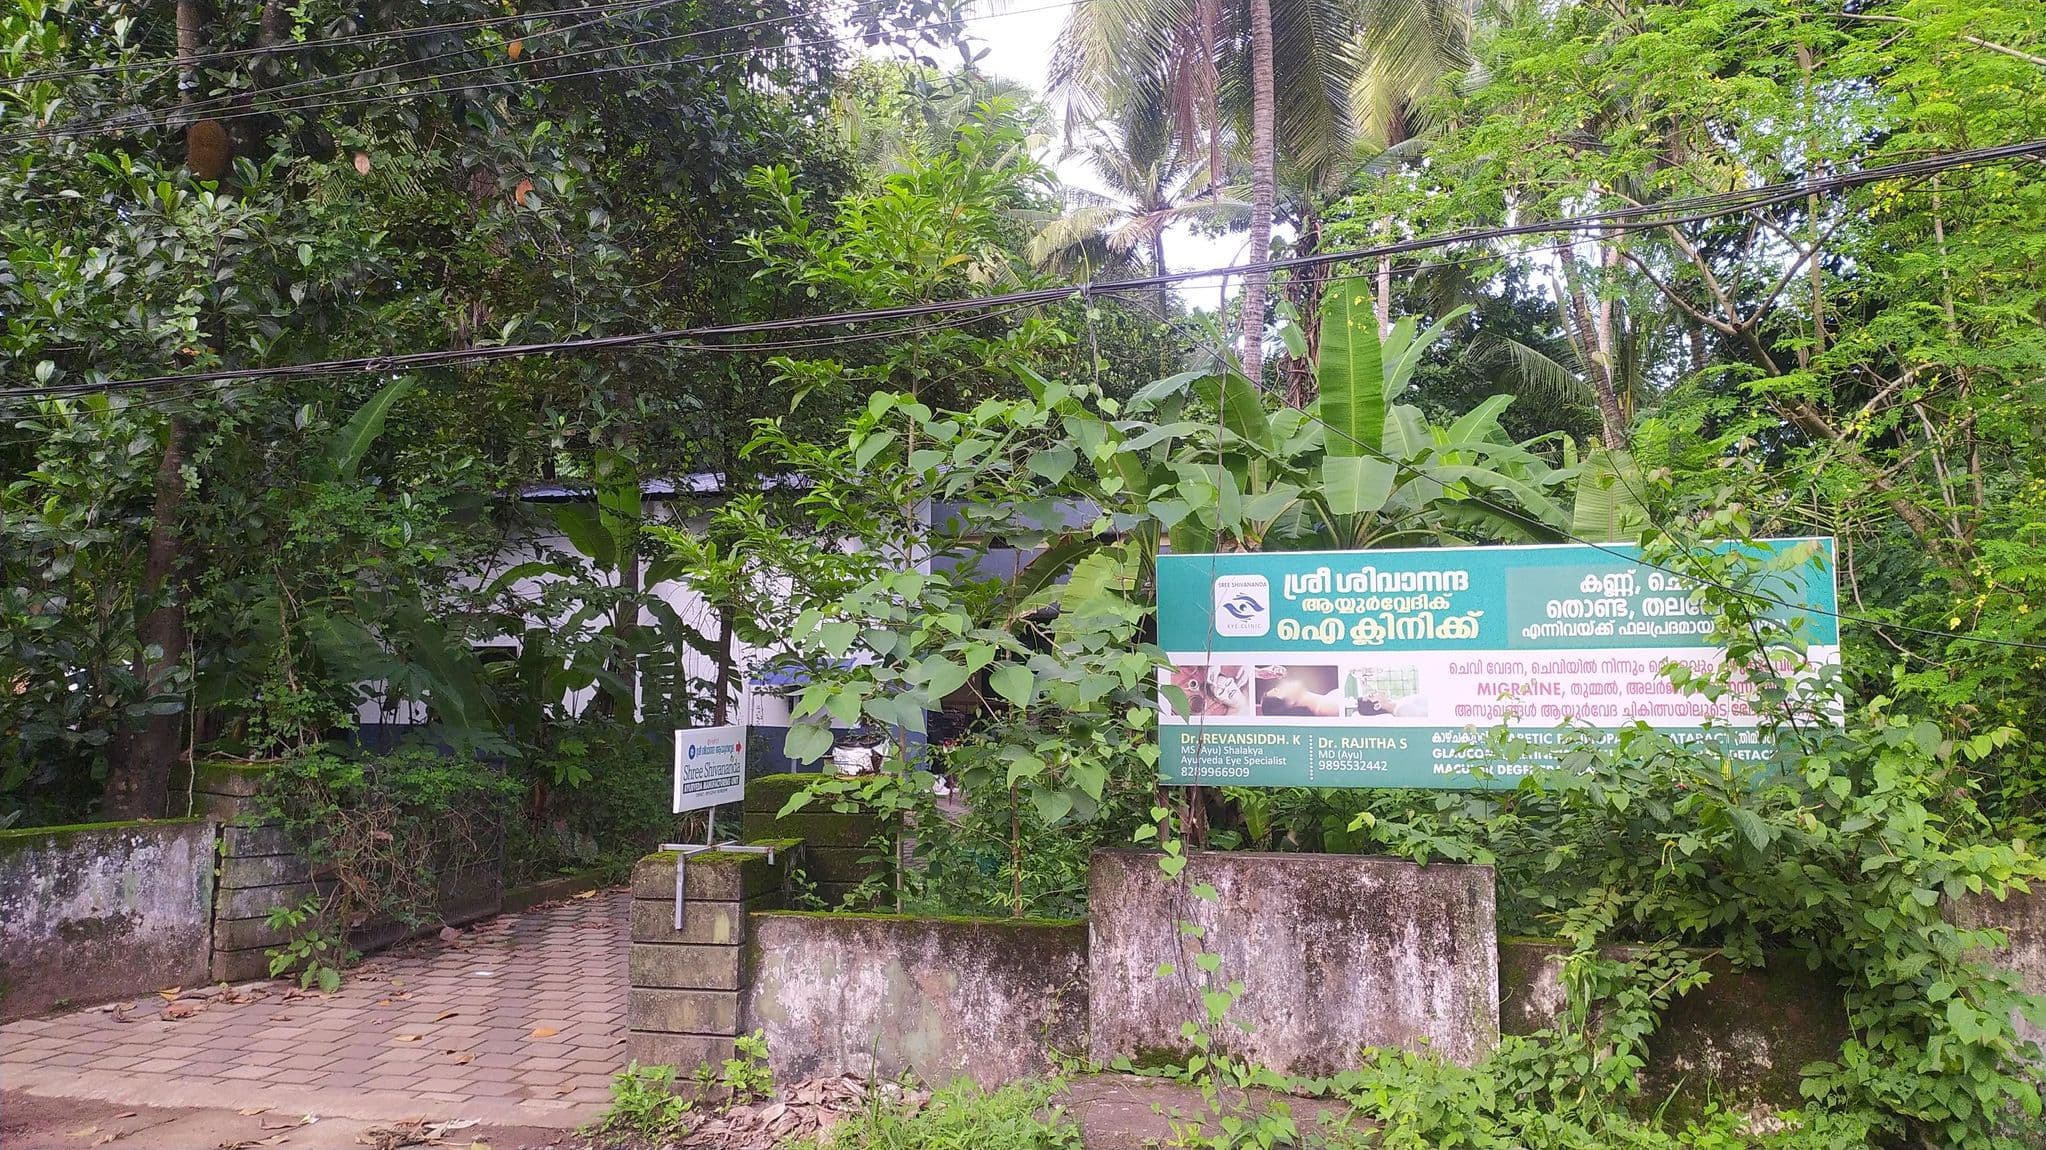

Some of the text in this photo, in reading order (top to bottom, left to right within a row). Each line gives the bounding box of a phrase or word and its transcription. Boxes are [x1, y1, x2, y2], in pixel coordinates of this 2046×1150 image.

[1284, 566, 1469, 600] ശ്രീ ശിവാനന്ദ
[1580, 568, 1641, 598] കണ്ണ്,
[1546, 598, 1636, 621] തൊണ്ട,
[1277, 610, 1485, 646] ഐ ക്ലിനിക്ക്
[1521, 619, 1715, 640] എന്നിവയ്ക്ക് ഫലപ്രദമായ
[1449, 659, 1483, 675] ചെവി
[1486, 661, 1528, 676] വേദന,
[1531, 658, 1598, 675] ചെവിയിൽ
[1601, 657, 1645, 677] നിന്നും
[1477, 681, 1567, 699] MIGRAINE,
[1181, 732, 1302, 746] Dr. REVANSIDDH. K
[1318, 737, 1408, 750] Dr. RAJITHA S
[1181, 745, 1196, 755] MS
[1223, 745, 1264, 758] Shalakya
[1318, 750, 1363, 761] MD (Ayu)
[683, 759, 741, 781] Shree Shivananda
[1180, 755, 1287, 767] Ayurveda Eye Specialist
[1318, 760, 1389, 772] 9895532442
[1181, 766, 1250, 778] 8289966909
